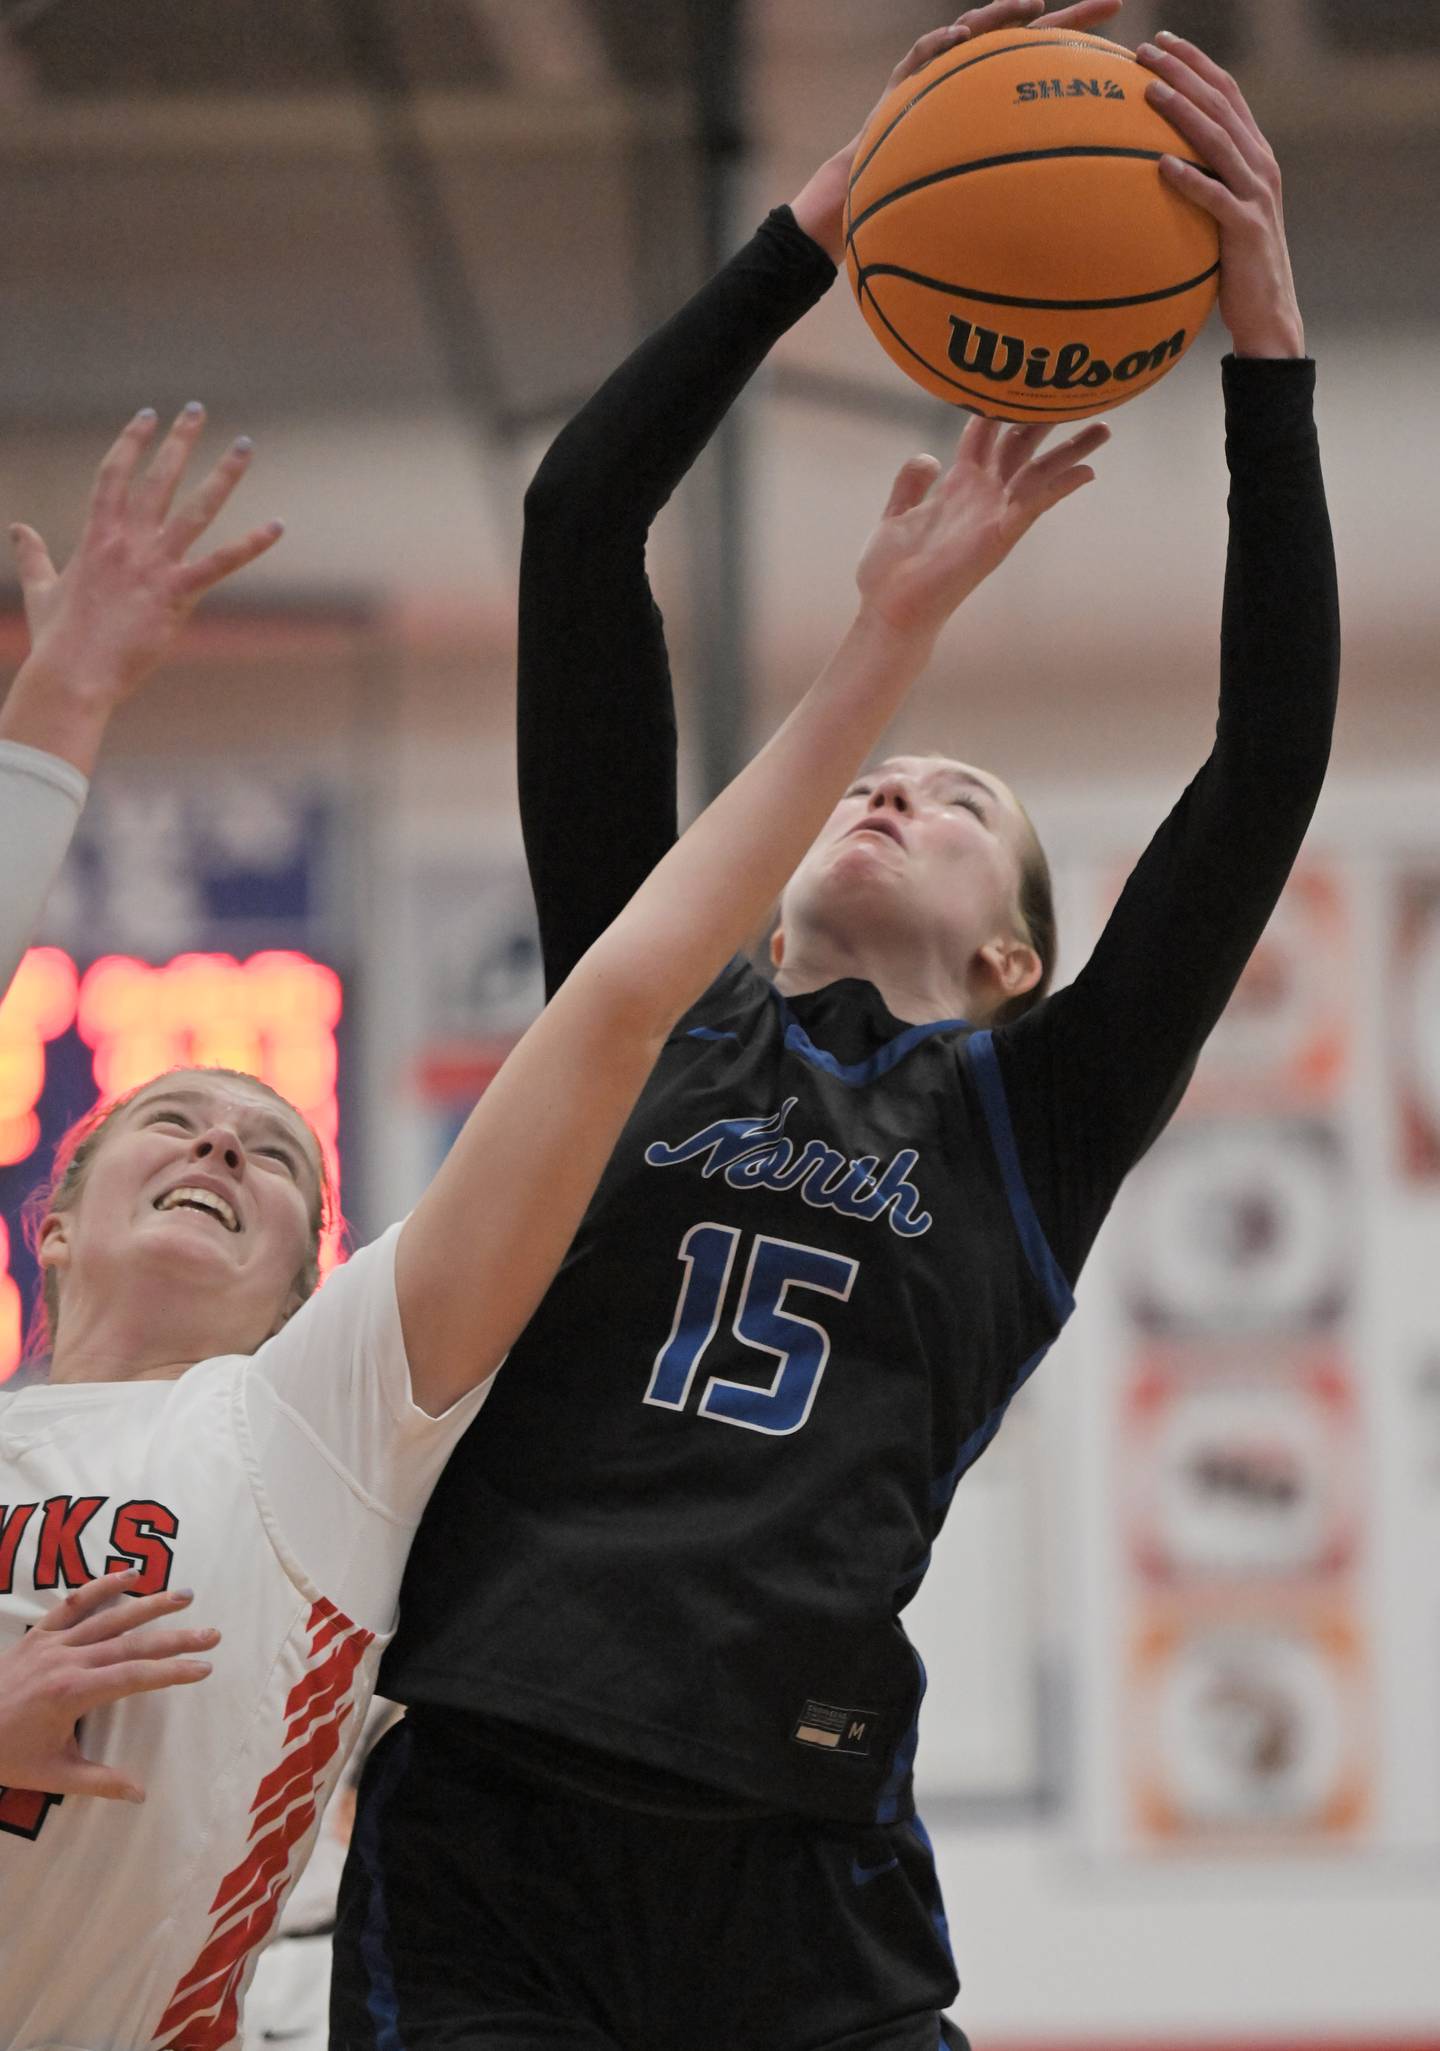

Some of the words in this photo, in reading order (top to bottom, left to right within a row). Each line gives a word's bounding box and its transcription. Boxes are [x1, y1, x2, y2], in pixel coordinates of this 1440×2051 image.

[948, 314, 1186, 390] Wilson
[644, 1097, 933, 1238] North
[642, 1221, 861, 1435] 15
[847, 1721, 866, 1741] M
